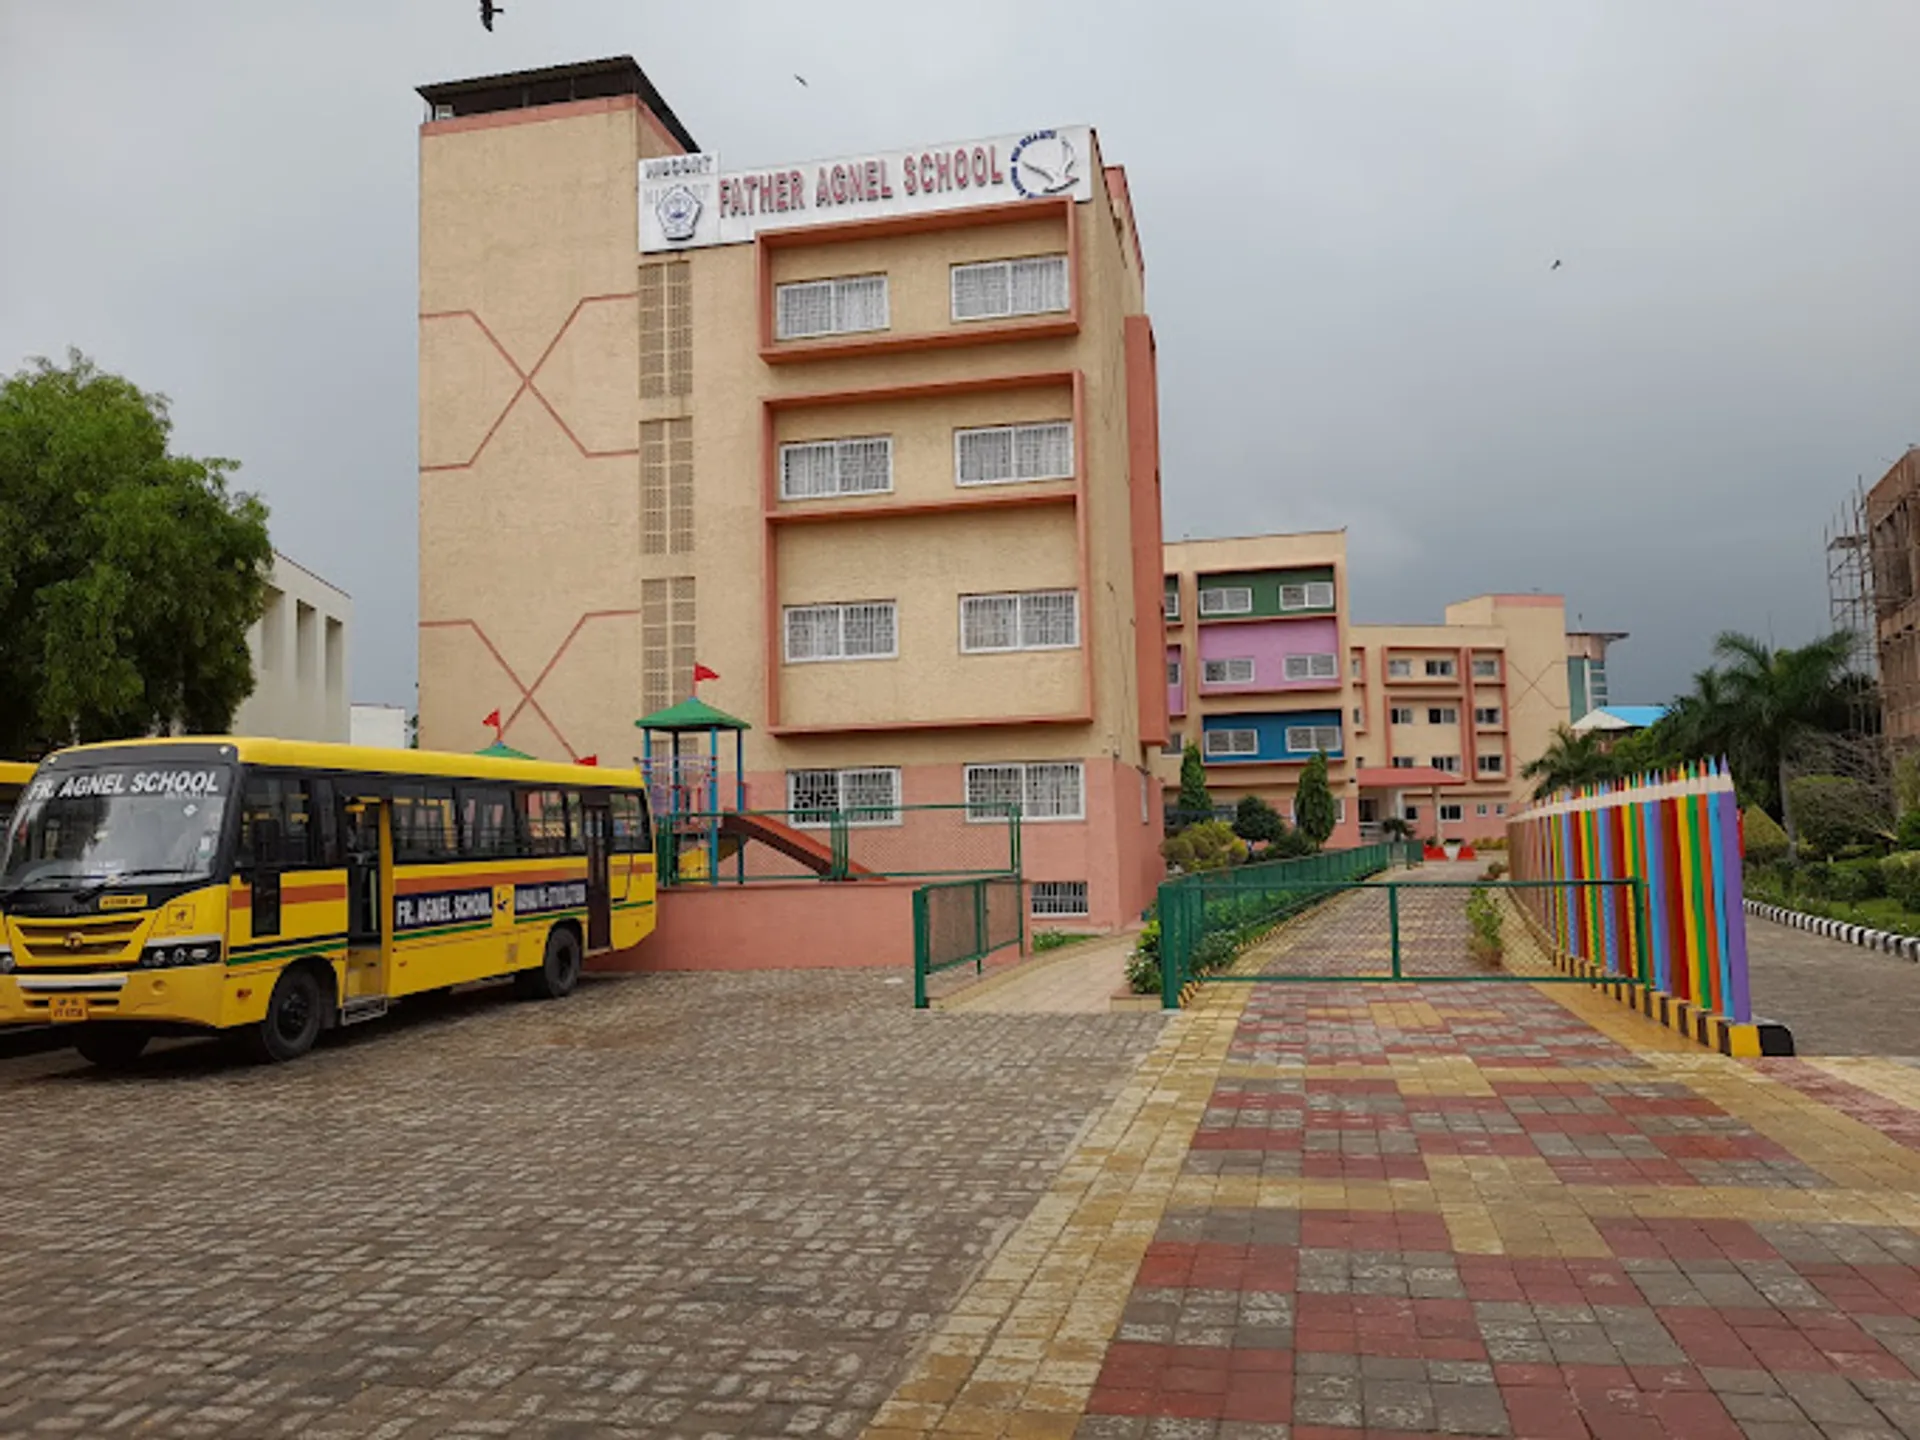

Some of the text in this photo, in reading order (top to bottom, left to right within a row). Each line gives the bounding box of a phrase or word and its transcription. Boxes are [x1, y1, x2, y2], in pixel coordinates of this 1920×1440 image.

[720, 170, 805, 218] FATHER
[815, 159, 893, 207] AGNEL
[904, 145, 1003, 196] SCHOOL
[59, 773, 126, 799] AGNEL
[130, 771, 219, 793] SCHOOL
[418, 897, 453, 922] AGNEL
[454, 892, 492, 919] SCHOOL
